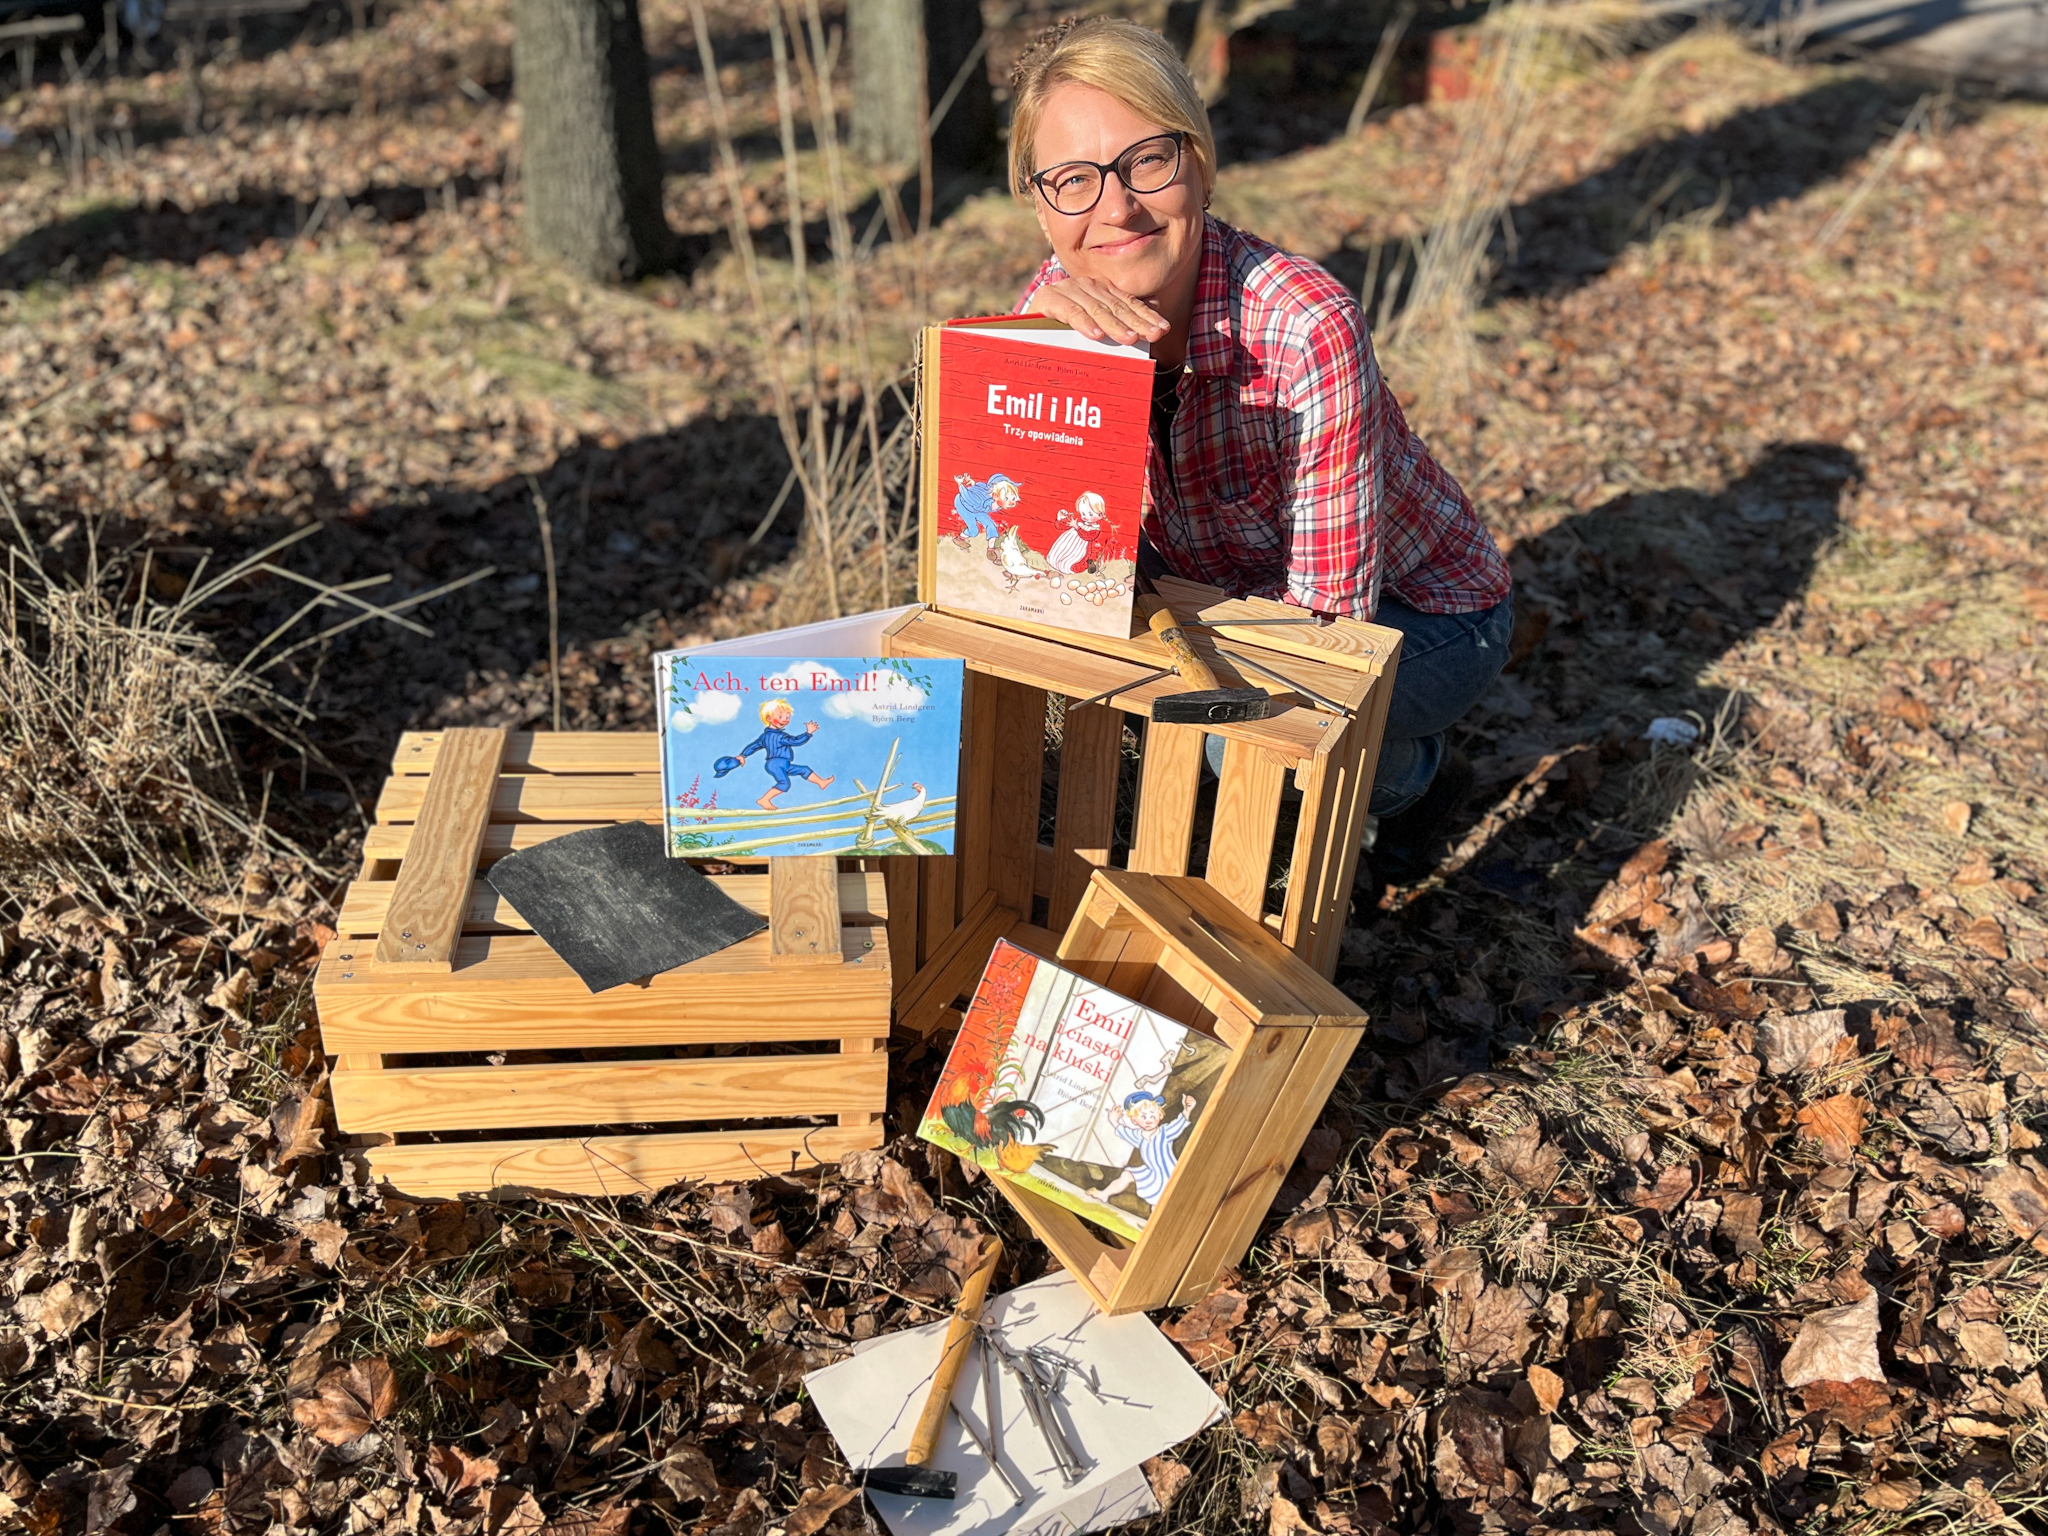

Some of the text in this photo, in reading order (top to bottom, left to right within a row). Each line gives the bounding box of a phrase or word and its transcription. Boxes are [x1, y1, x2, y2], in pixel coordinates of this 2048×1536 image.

[1004, 358, 1090, 378] Astrid Lindgren Björn Berg
[987, 384, 1101, 428] Emil i Ida
[1003, 423, 1084, 446] Trzy opowiadania
[692, 671, 877, 694] Ach, ten Emil!
[872, 702, 936, 712] Astrid Lindgren
[872, 715, 915, 723] Björn Berg
[1074, 998, 1133, 1040] Emil
[1056, 1019, 1121, 1061] i ciasto
[1024, 1033, 1113, 1083] na kluski
[1044, 1068, 1102, 1101] Astrid Lindgren
[1057, 1088, 1098, 1113] Björn Berg
